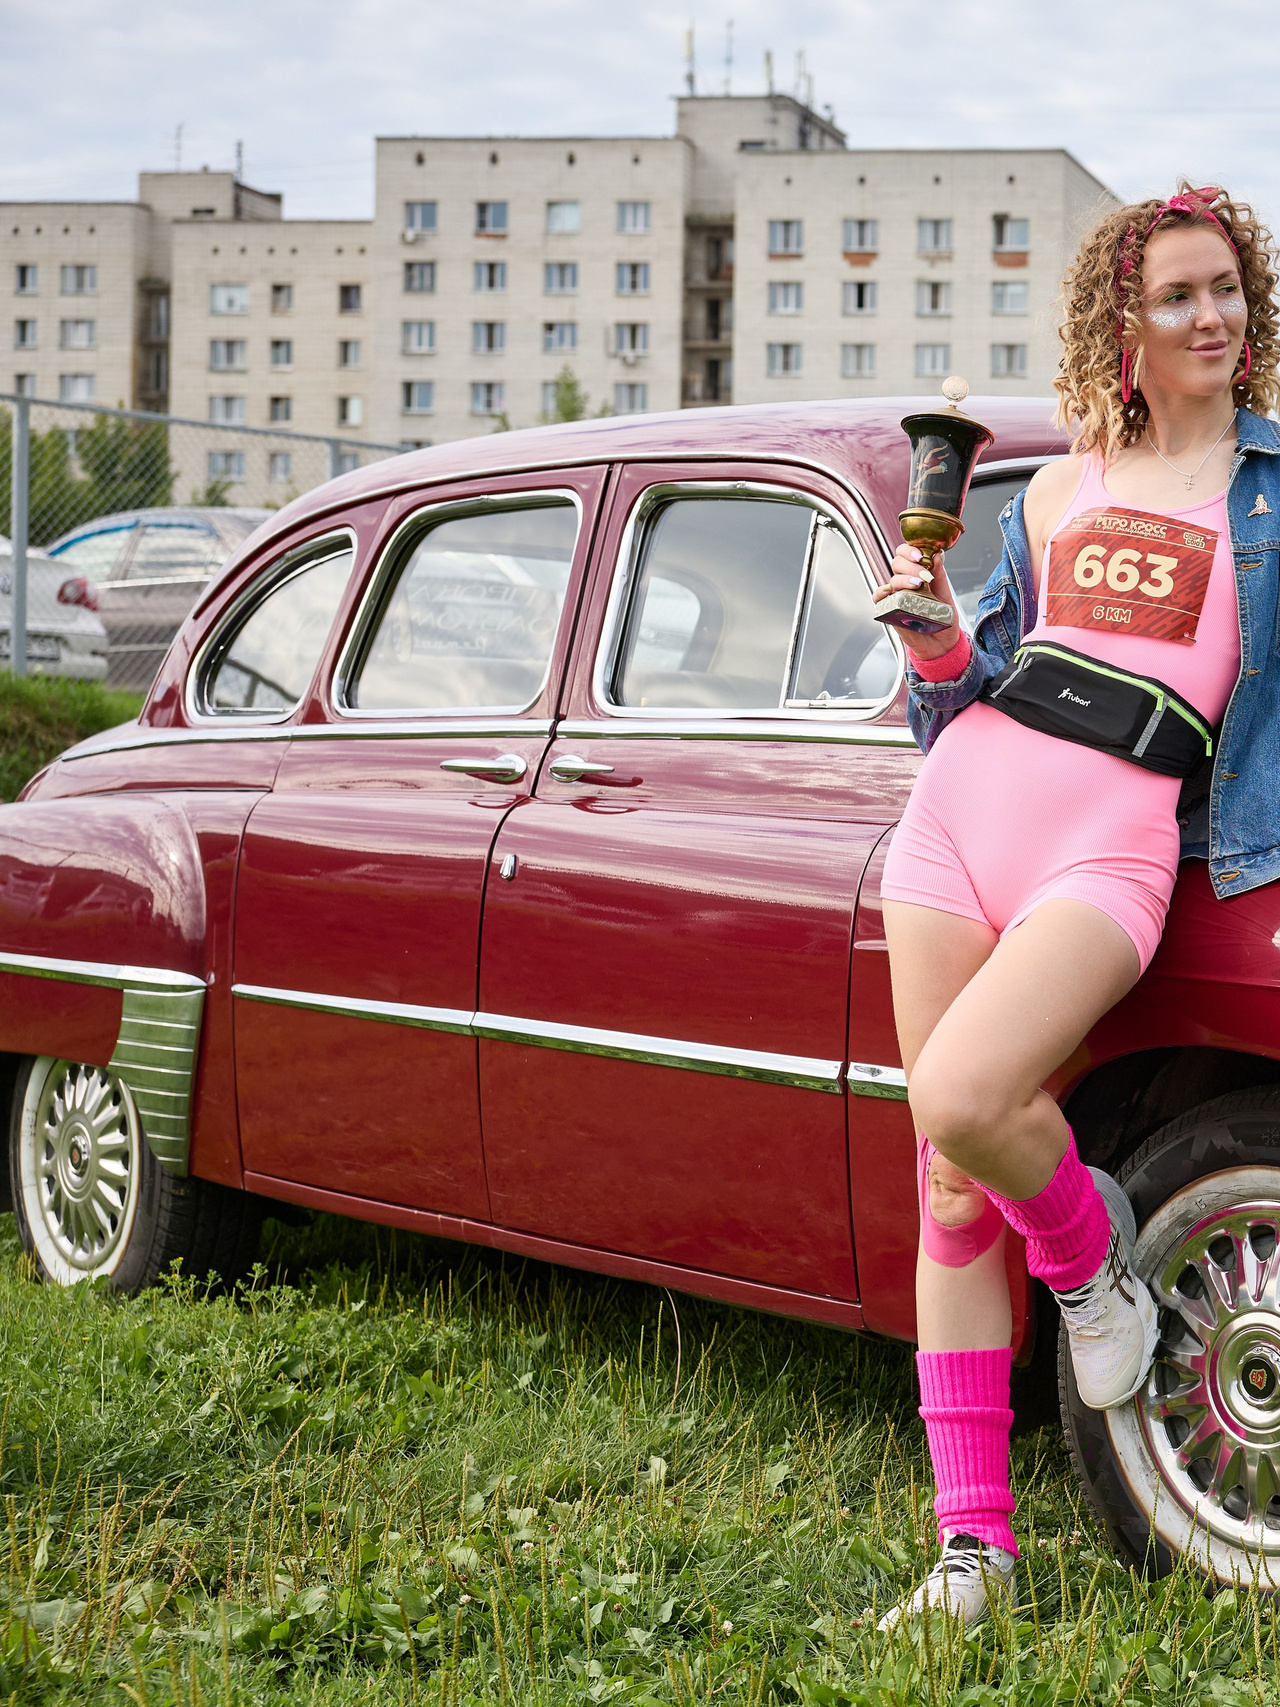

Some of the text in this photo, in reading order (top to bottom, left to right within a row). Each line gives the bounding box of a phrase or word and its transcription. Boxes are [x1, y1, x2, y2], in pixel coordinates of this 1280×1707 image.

[1096, 516, 1129, 529] РЕТРО
[1130, 520, 1168, 536] КРОСС
[1073, 544, 1179, 598] 663
[1092, 605, 1104, 620] 6
